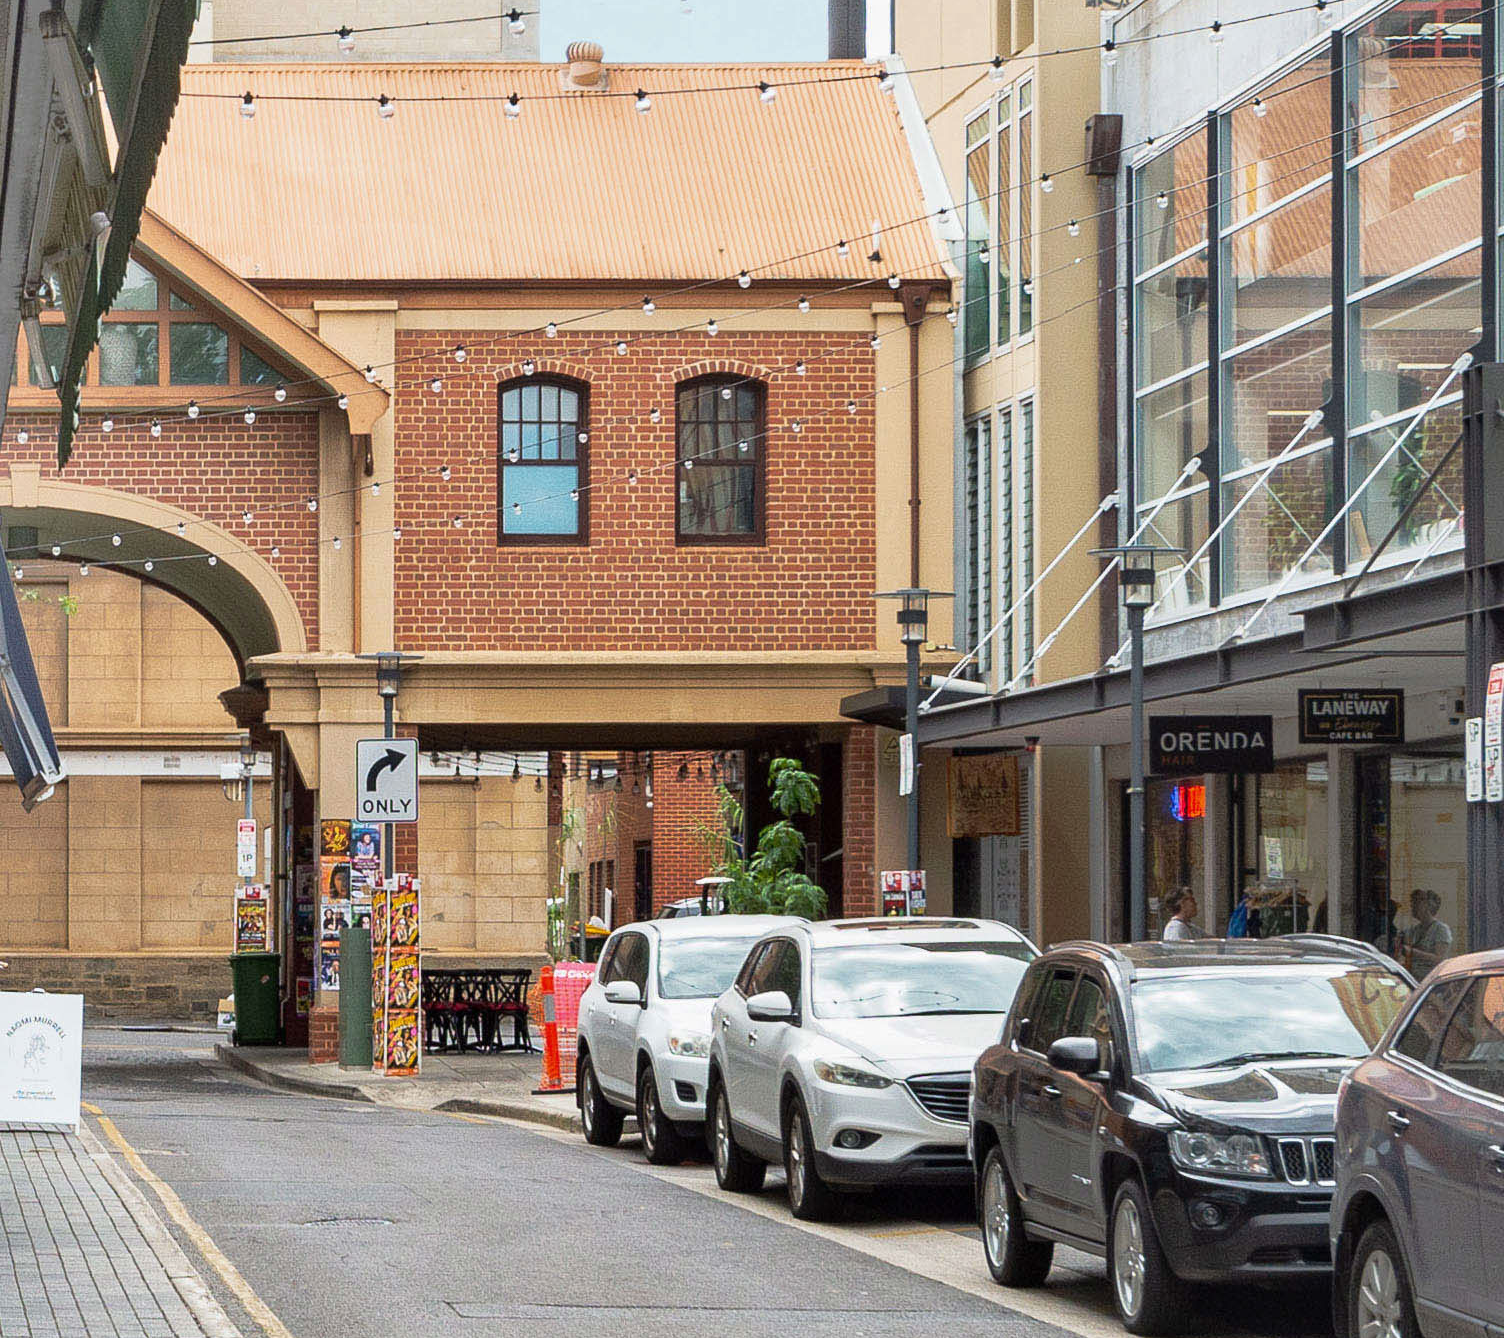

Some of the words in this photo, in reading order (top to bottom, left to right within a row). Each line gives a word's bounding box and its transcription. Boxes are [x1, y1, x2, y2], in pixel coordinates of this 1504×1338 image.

[1312, 701, 1389, 715] LANEWAY
[1160, 732, 1265, 752] ORENDA
[1330, 732, 1352, 740] CAFE
[1355, 732, 1373, 740] BAR
[362, 799, 412, 813] ONLY
